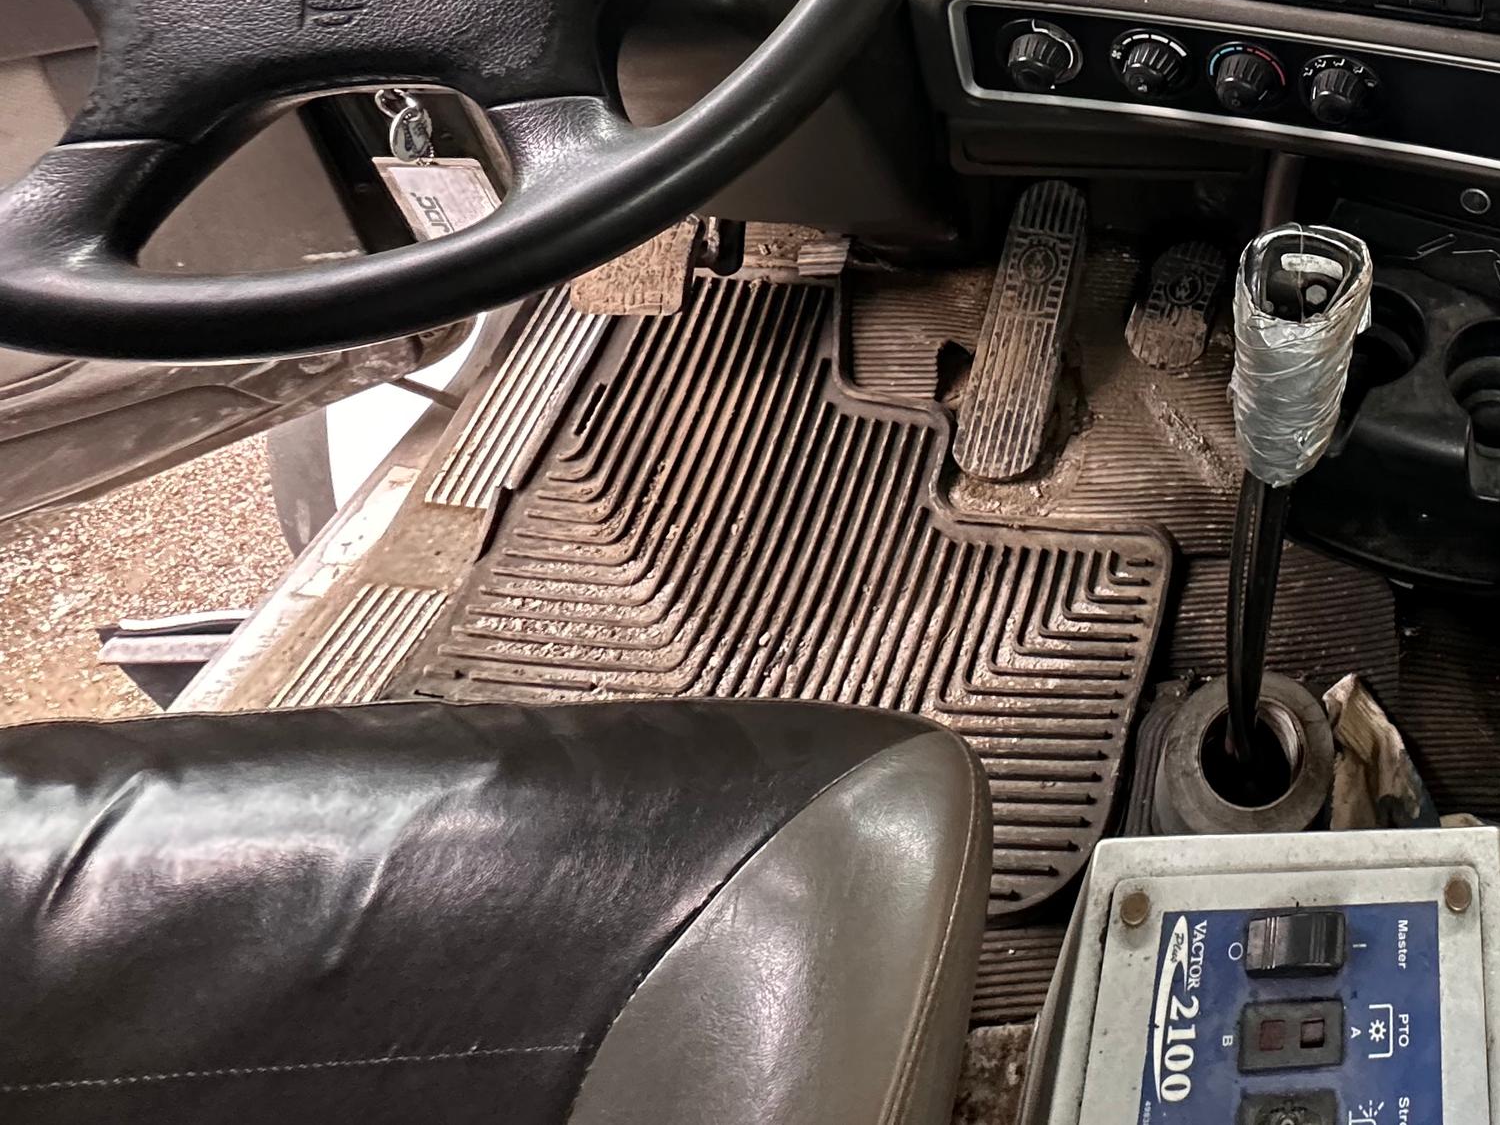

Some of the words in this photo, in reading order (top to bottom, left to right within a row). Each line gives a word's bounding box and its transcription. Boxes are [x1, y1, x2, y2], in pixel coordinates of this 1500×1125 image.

[1170, 933, 1185, 963] Plus
[1187, 919, 1207, 991] VACTOR
[1397, 919, 1409, 969] Master
[1222, 1035, 1234, 1047] B
[1351, 1027, 1362, 1039] A
[1398, 1014, 1410, 1048] PTO
[1160, 995, 1200, 1103] 2100
